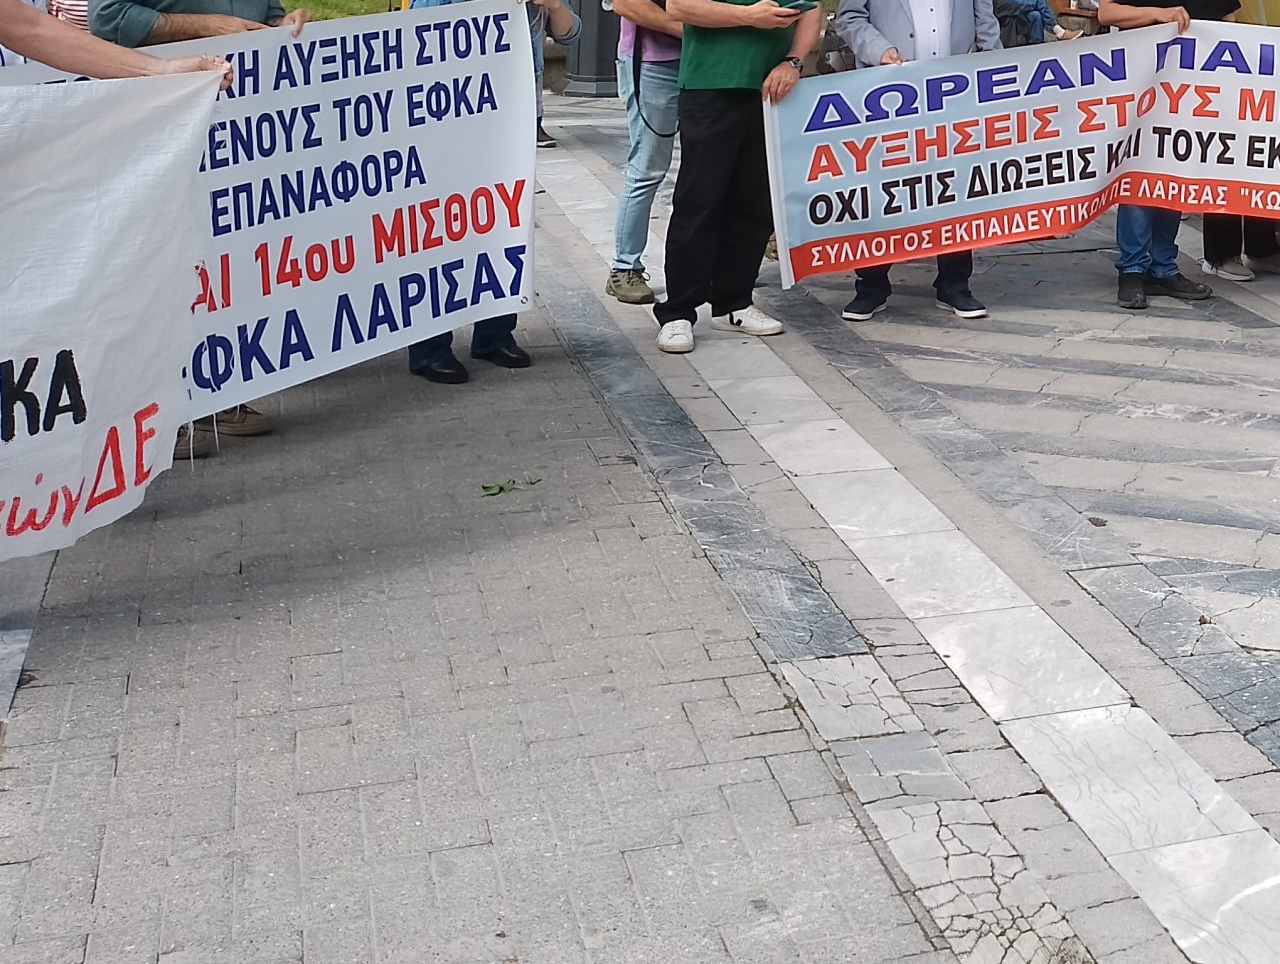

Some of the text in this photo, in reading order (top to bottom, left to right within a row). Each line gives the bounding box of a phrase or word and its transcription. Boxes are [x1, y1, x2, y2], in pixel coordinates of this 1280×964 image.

[273, 28, 403, 91] ΑΥΞΗΣΗ
[415, 13, 511, 67] ΣΤΟΥΣ
[804, 48, 1127, 132] ΔΩΡΕΑΝ
[199, 73, 498, 172] ΕΝΟΥΣ ΤΟΥ ΕΦΚΑ
[808, 105, 1060, 182] ΑΥΞΗΣΕΙΣ
[1077, 82, 1221, 133] ΣΤΟΥΣ
[210, 146, 426, 237] ΕΠΑΝΑΦΟΡΑ
[809, 186, 869, 224] ΟΧΙ
[882, 171, 956, 216] ΣΤΙΣ
[966, 146, 1097, 200] ΔΙΩΞΕΙΣ
[1106, 128, 1142, 174] ΚΑΙ
[1152, 126, 1237, 165] ΤΟΥΣ
[811, 229, 933, 266] ΣΥΛΛΟΓΟΣ
[940, 194, 1107, 245] ΕΚΠΑΙΔΕΥΤΙΚΩΝ
[1109, 178, 1131, 201] ΠΕ
[1138, 178, 1228, 205] ΛΑΡΙΣΑΣ
[254, 235, 355, 296] 14ου
[372, 179, 526, 264] ΜΙΣΘΟΥ
[182, 245, 526, 393] ΦΚΑ ΛΑΡΙΣΑΣ
[0, 349, 87, 442] ΚΑ
